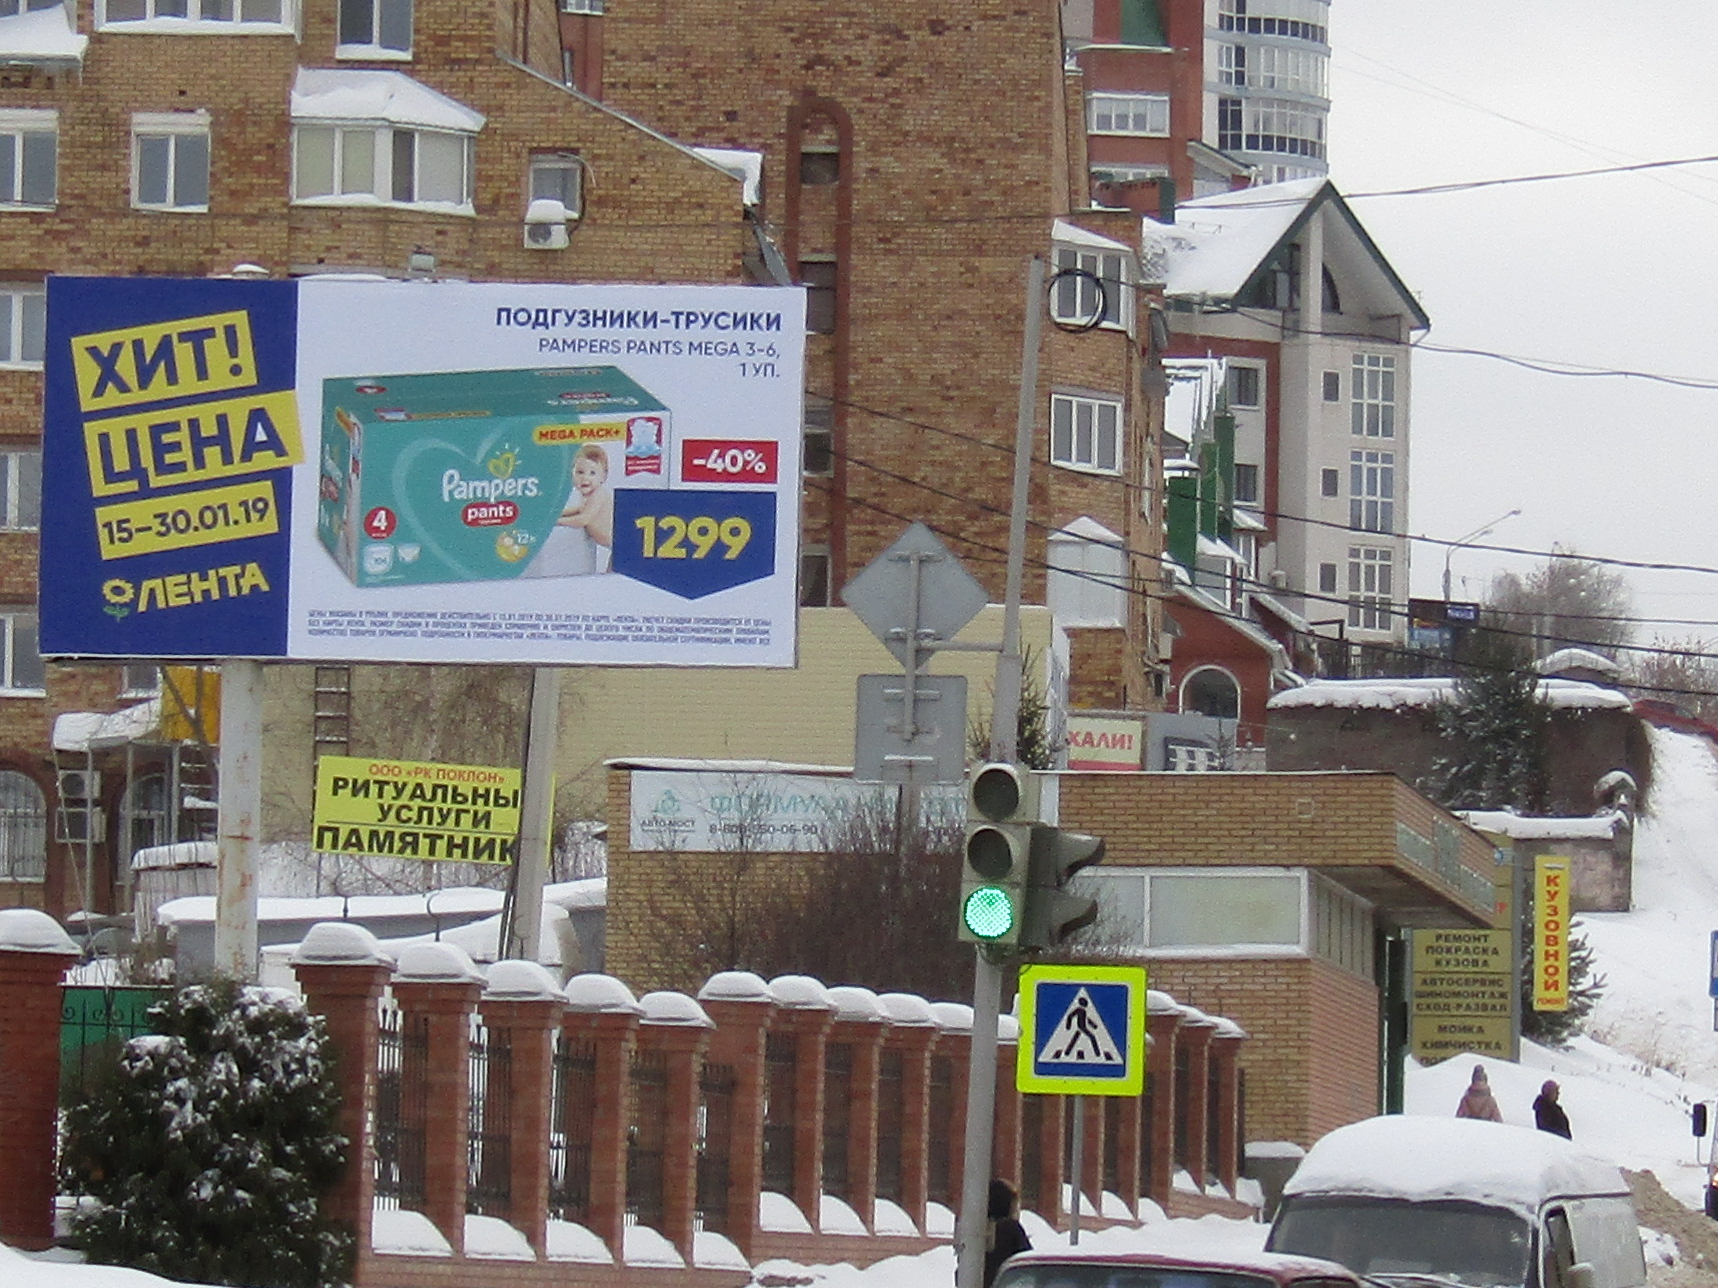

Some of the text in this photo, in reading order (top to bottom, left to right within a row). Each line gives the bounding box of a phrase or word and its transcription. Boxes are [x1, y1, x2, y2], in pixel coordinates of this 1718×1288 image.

[496, 307, 781, 332] ПОДГУЗНИКИ-ТРУСИКИ
[539, 338, 780, 359] PAMPERS PANTS MEGA 3-6,
[85, 324, 242, 399] ХИТ!
[740, 363, 780, 378] 1 УП.
[539, 430, 575, 441] MEGA
[98, 407, 289, 489] ЦЕНА
[692, 449, 766, 474] -40%
[442, 469, 539, 503] Pampers
[372, 510, 388, 530] 4
[468, 505, 513, 522] pants
[635, 516, 752, 560] 1299
[137, 562, 270, 613] ЛЕНТА
[1068, 731, 1134, 750] ХАЛИ!
[369, 763, 402, 777] ООО
[332, 777, 520, 808] РИТУАЛЬНЫ
[378, 803, 491, 830] УСЛУГИ
[316, 825, 517, 862] ПАМЯТНИК
[1435, 934, 1489, 943] РЕМОНТ
[1426, 946, 1499, 955] ПОКРАСКА
[1435, 959, 1488, 967] КУЗОВА
[1421, 978, 1503, 987] АВТОСЕРВИС
